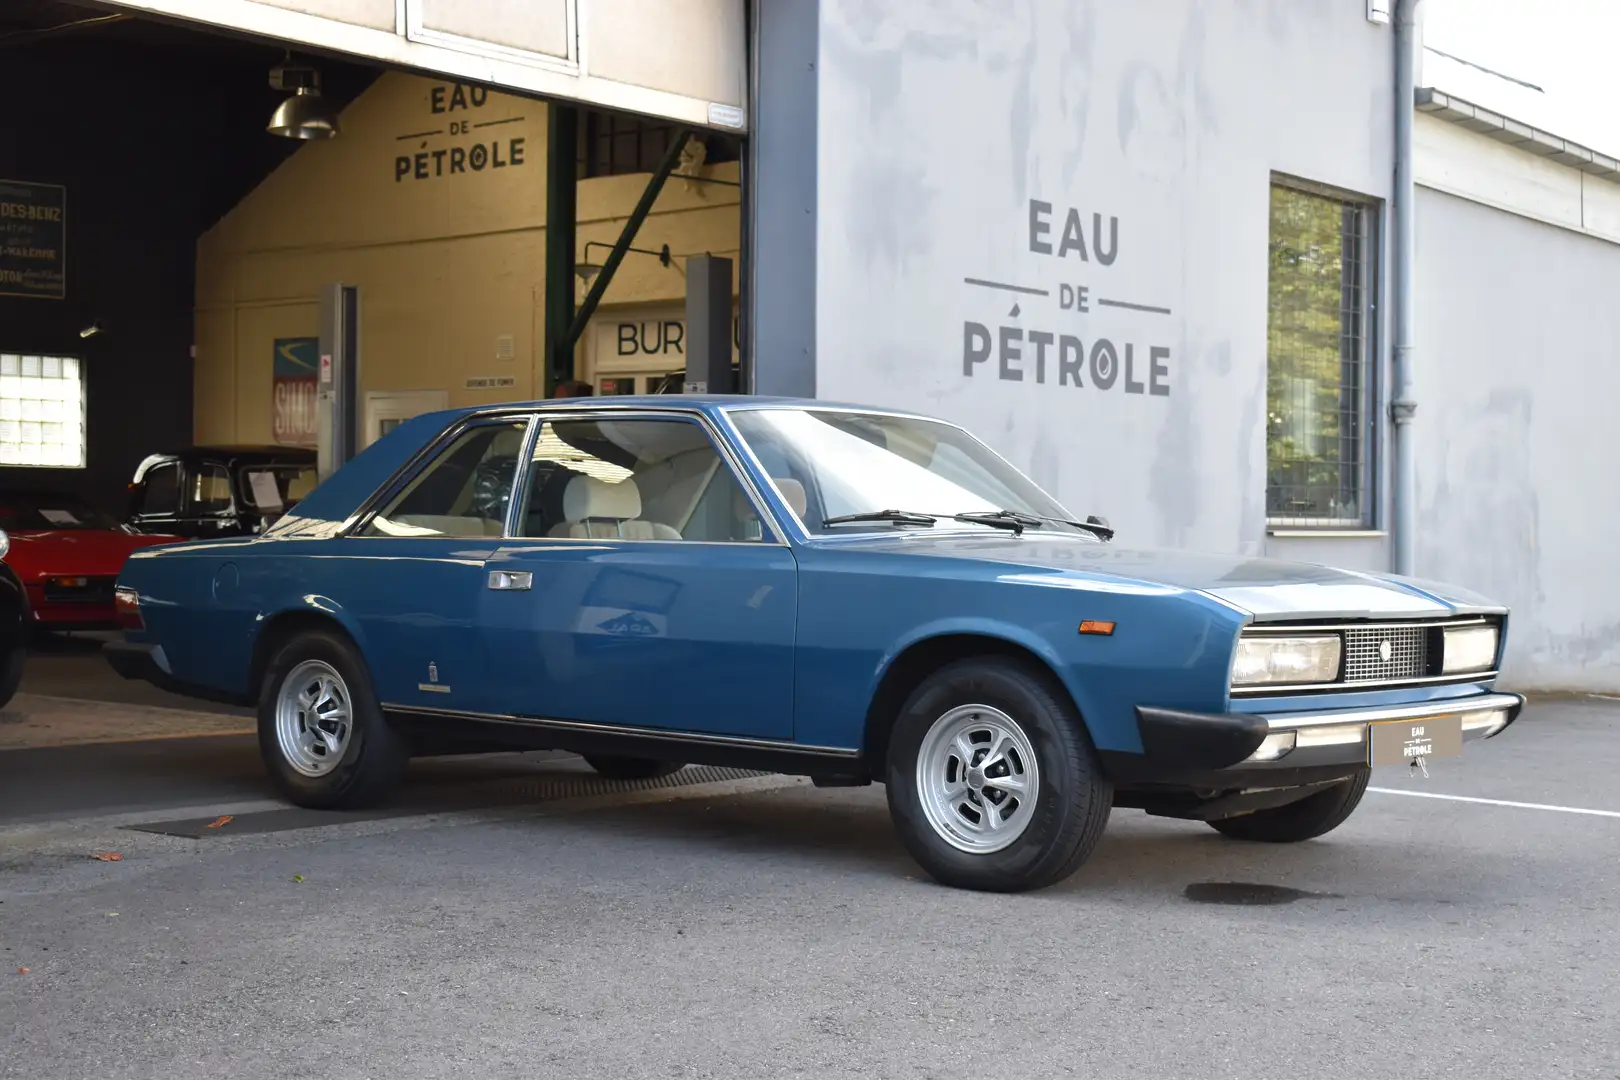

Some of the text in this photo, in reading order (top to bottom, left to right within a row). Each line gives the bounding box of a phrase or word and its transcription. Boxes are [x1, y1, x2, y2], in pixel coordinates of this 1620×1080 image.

[431, 83, 488, 114] EAU
[449, 120, 470, 136] DE
[395, 138, 526, 183] PÉTROLE
[1029, 198, 1119, 267] EAU
[1059, 283, 1090, 314] DE
[963, 303, 1170, 397] PÉTROLE
[274, 381, 317, 435] SIMC
